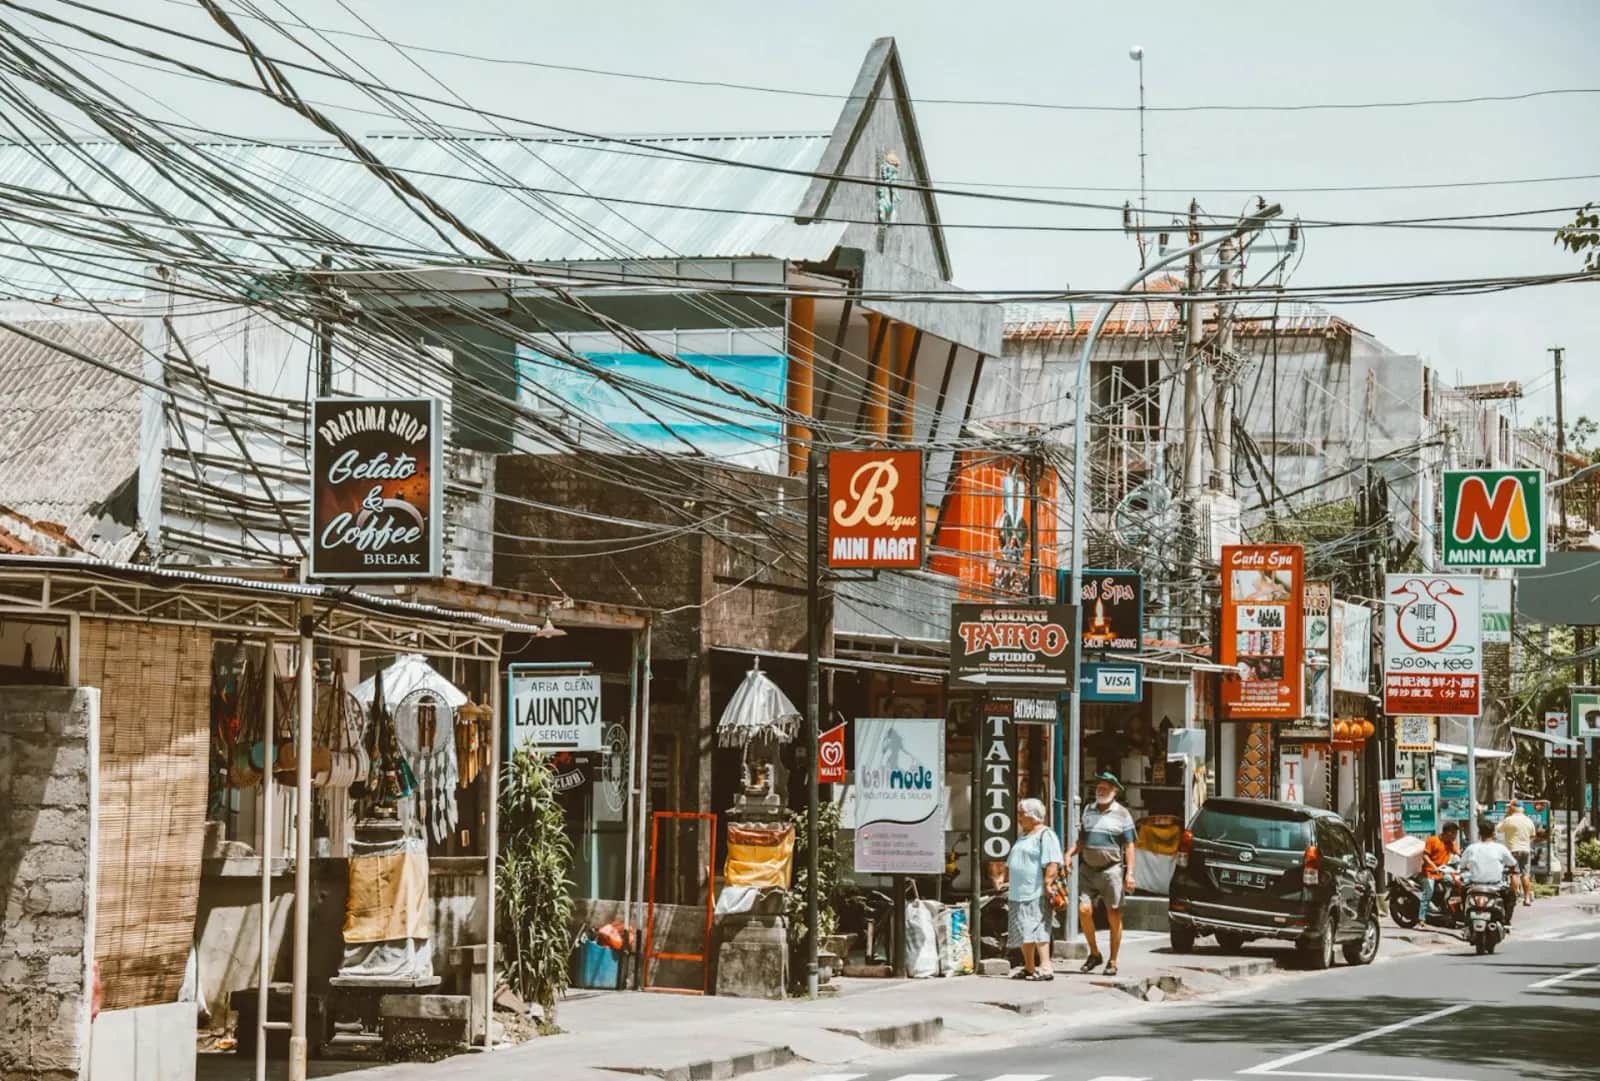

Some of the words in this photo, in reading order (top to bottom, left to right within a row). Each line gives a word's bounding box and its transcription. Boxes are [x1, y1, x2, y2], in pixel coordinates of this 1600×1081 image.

[319, 406, 386, 446] PRATAMA
[389, 408, 428, 444] SHOP
[329, 450, 416, 484] Gelato
[363, 486, 384, 512] &
[833, 458, 917, 531] Bagus
[321, 513, 421, 551] Coffee
[833, 538, 869, 560] MINI
[872, 538, 917, 560] MART
[1448, 549, 1486, 563] MINI
[1489, 549, 1536, 563] MART
[364, 554, 421, 565] BREAK
[1232, 551, 1264, 565] Carla
[1268, 551, 1292, 568] Spa
[1101, 577, 1134, 605] Spa
[981, 609, 1049, 622] AGUNG
[959, 622, 1069, 657] TATTOO
[988, 652, 1036, 662] STUDIO
[1391, 656, 1439, 671] SOON
[564, 681, 593, 691] CLEAN
[1104, 676, 1131, 687] VISA
[515, 697, 599, 726] LAUNDRY
[539, 730, 580, 740] SERVICE
[821, 767, 842, 777] WALL'S
[984, 716, 1011, 858] TATTOO
